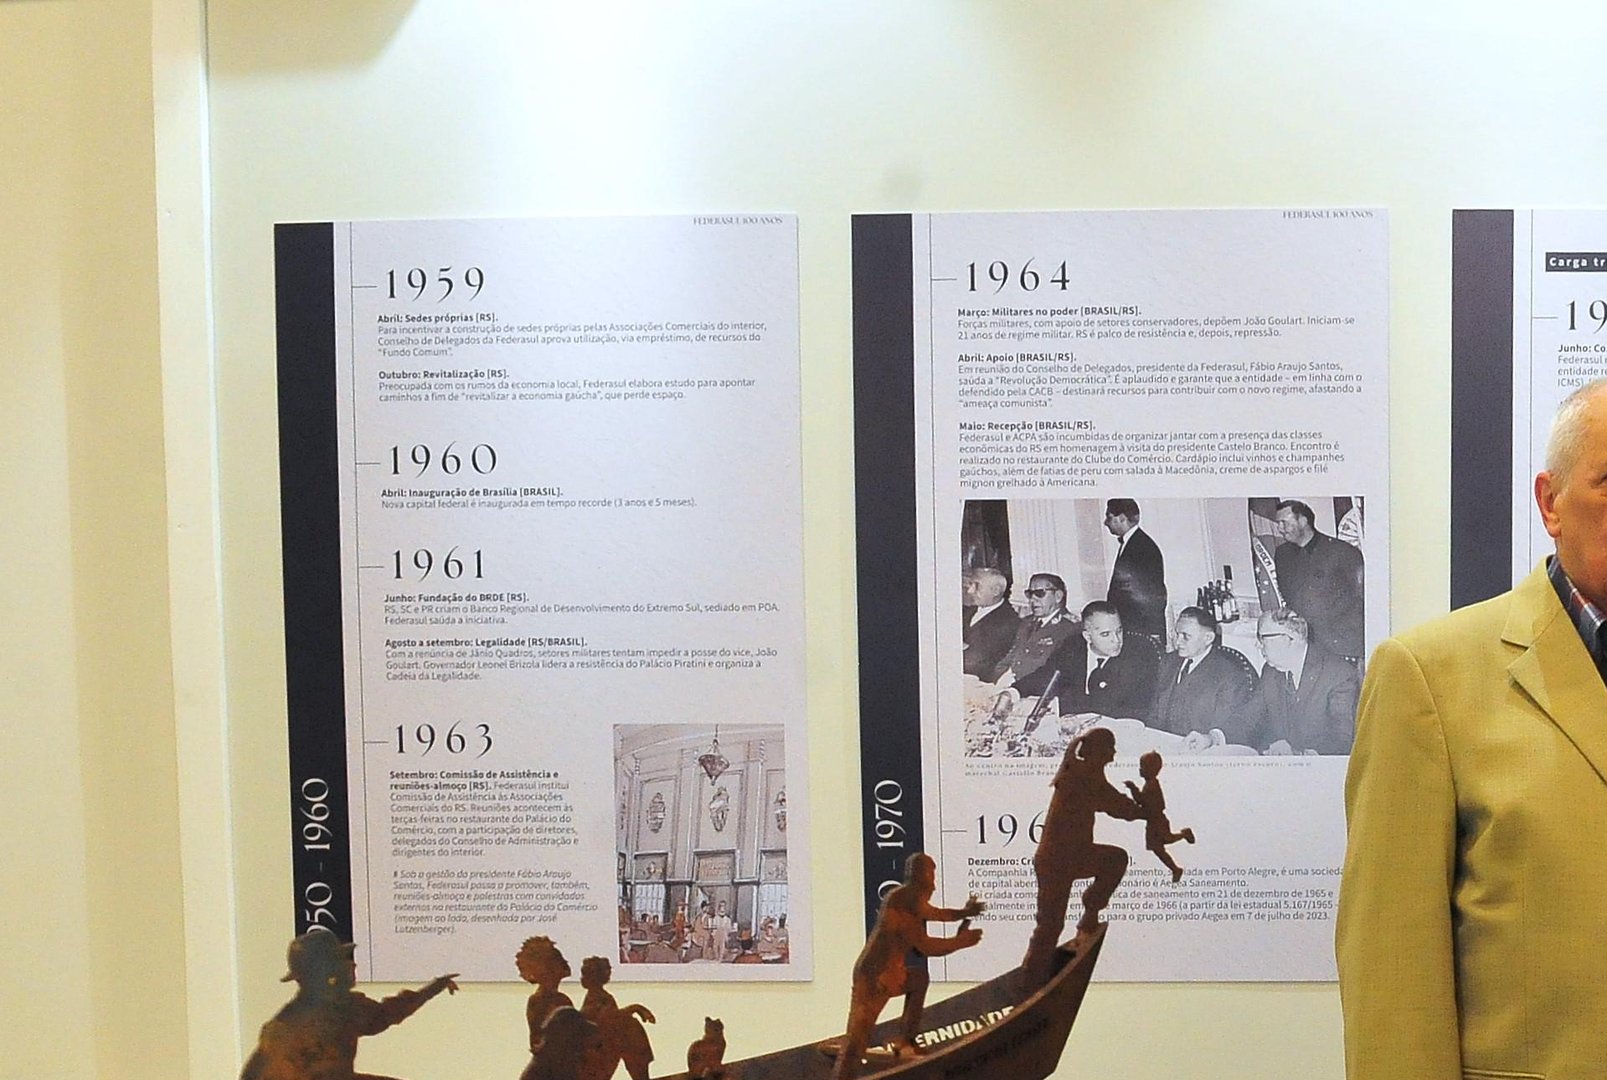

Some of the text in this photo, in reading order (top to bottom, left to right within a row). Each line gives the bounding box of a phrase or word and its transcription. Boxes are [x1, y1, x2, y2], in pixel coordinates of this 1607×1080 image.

[1548, 257, 1588, 269] Carga
[967, 256, 1071, 296] 1964
[387, 266, 486, 303] 1959
[376, 312, 498, 324] Abril: Sedes próprias [RS].
[957, 308, 990, 319] Março:
[991, 306, 1034, 317] Militares
[1049, 306, 1079, 318] poder
[1080, 304, 1142, 317] [BRASIL/RS].
[1557, 343, 1591, 353] Junho:
[957, 351, 1077, 364] Abril: Apoio [BRASIL/RS].
[378, 368, 510, 380] Outubro: Revitalização [RS].
[959, 420, 1096, 433] Maio: Recepção [BRASIL/RS].
[390, 440, 497, 479] 1960
[380, 487, 407, 497] Abril:
[408, 487, 467, 499] Inauguração
[482, 486, 518, 497] Brasília
[519, 487, 563, 498] [BRASIL].
[392, 545, 484, 583] 1961
[383, 593, 416, 602] Junho:
[417, 592, 463, 604] Fundação
[479, 592, 505, 602] BRDE
[506, 592, 529, 603] [RS].
[384, 638, 417, 649] Agosto
[425, 637, 473, 647] setembro:
[474, 637, 526, 649] Legalidade
[527, 636, 588, 648] [RS/BRASIL].
[395, 720, 494, 758] 1963
[389, 769, 438, 780] Setembro:
[439, 769, 484, 779] Comissão
[498, 768, 551, 779] Assistência
[389, 780, 492, 792] reuniões-almoço [RS].
[874, 780, 908, 849] 1970
[976, 812, 1047, 848] 196
[300, 777, 337, 936] 50 1960
[967, 856, 1019, 866] Dezembro:
